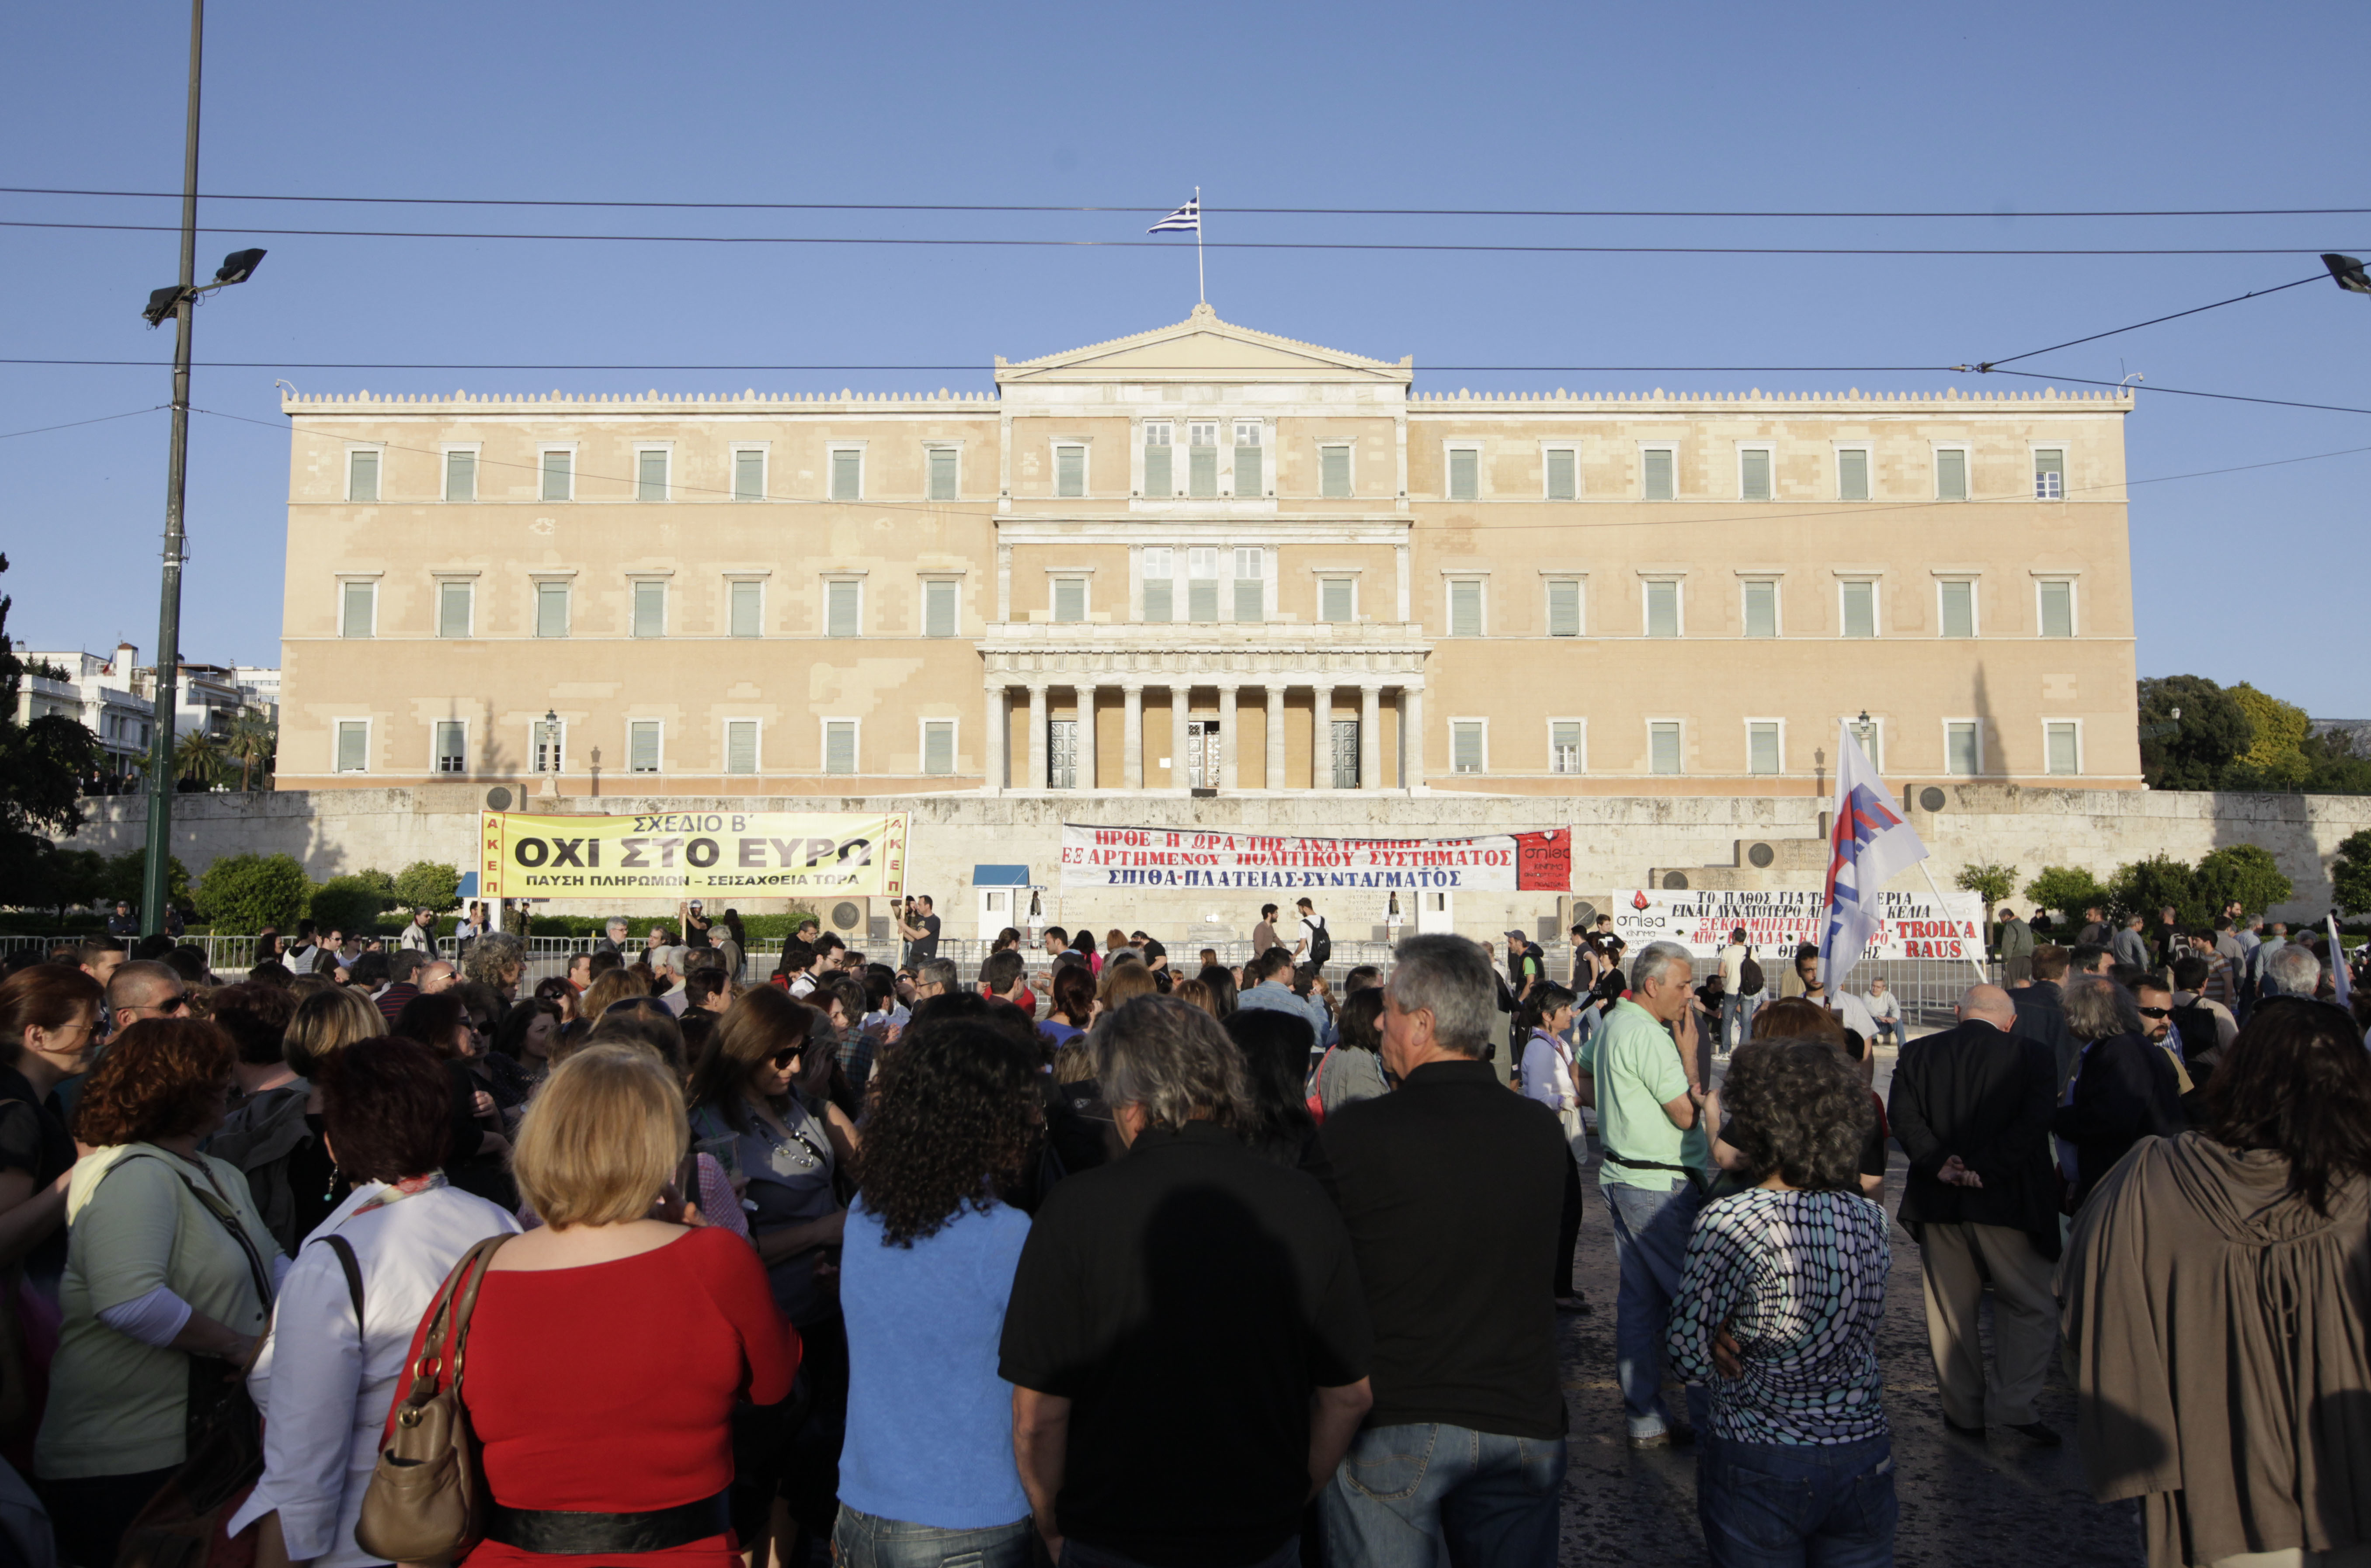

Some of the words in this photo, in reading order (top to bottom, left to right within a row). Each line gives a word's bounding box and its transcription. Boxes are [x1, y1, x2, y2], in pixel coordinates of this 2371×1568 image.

[633, 815, 723, 833] ΣΧΕΔΙΟ
[1095, 830, 1151, 846] ΗΡΘΕ
[1166, 833, 1180, 847] Η
[1191, 834, 1236, 851] ΩΡΑ
[1246, 836, 1286, 851] ΤΗΣ
[515, 837, 600, 867] ΟΧΙ
[620, 837, 720, 868] ΣΤΟ
[738, 838, 872, 868] ΕΥΡΩ
[1236, 851, 1355, 867] ΠΟΛΙΤΙΚΟΥ
[1369, 850, 1512, 867] ΣΥΣΤΗΜΑΤΟΣ
[527, 875, 584, 886] ΠΑΥΣΗ
[591, 875, 689, 886] ΠΛΗΡΩΜΩΝ
[707, 874, 808, 886] ΣΕΙΣΑΧΘΕΙΑ
[813, 874, 859, 885] ΤΩΡΑ
[1697, 892, 1715, 903] ΤΟ
[1724, 892, 1771, 905] ΠΑΘΟΣ
[1780, 892, 1804, 904] ΓΙΑ
[1672, 904, 1711, 917] ΕΙΝΑΙ
[1715, 905, 1801, 918] ΔΥΝΑΤΟΤΕΡΟ
[1887, 905, 1930, 919] ΚΕΛΙΑ
[1699, 918, 1821, 931] ΞΕΚΟΥΜΠΙΣΤΕΙΤ
[1896, 920, 1977, 939] TROIKA
[1690, 931, 1716, 944] ΑΠΟ
[1904, 940, 1961, 958] RAUS
